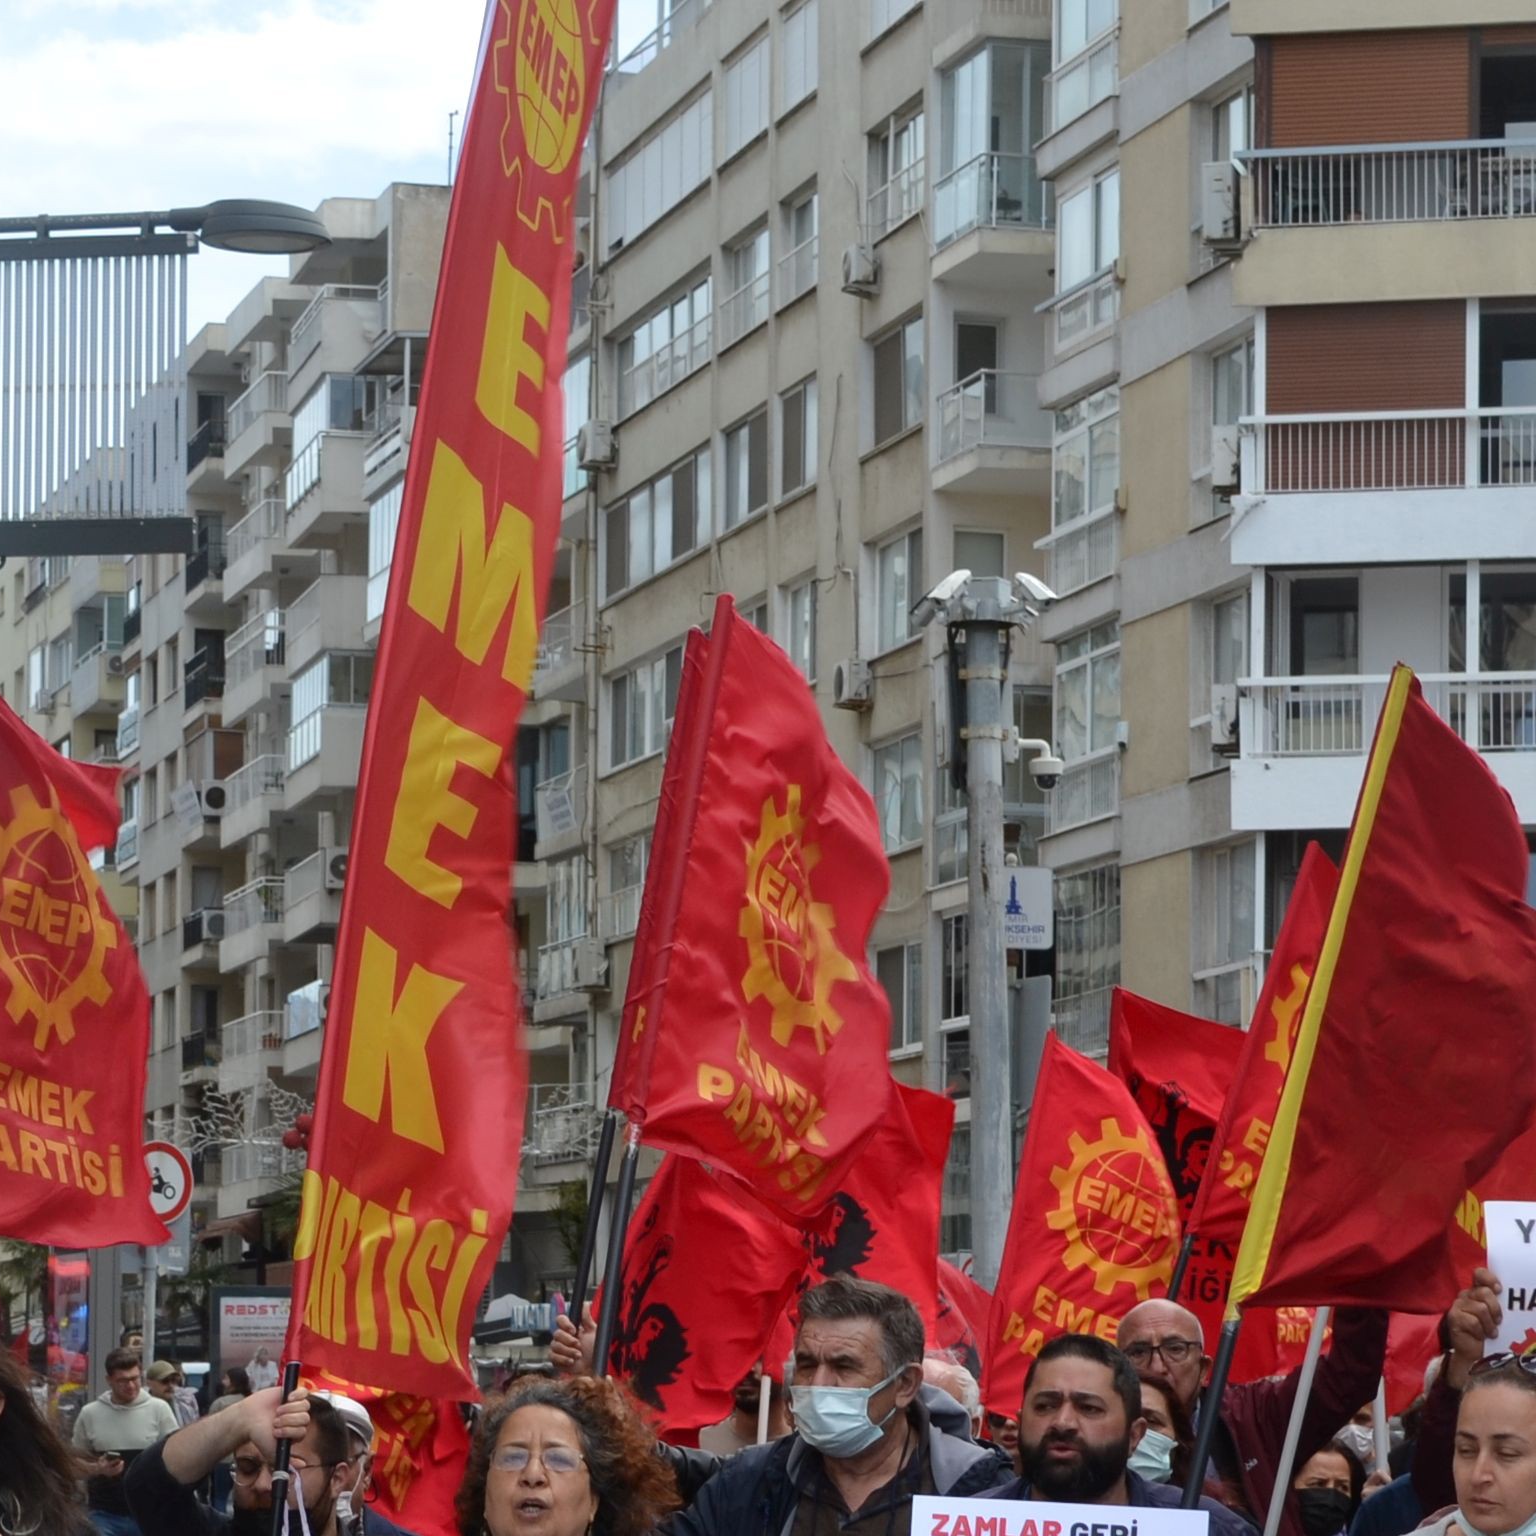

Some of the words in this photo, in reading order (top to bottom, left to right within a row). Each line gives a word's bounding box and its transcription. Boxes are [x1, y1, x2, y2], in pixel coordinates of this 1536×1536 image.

[519, 0, 581, 128] EMEP
[343, 240, 550, 1155] EMEK
[735, 1020, 830, 1150] EMEK
